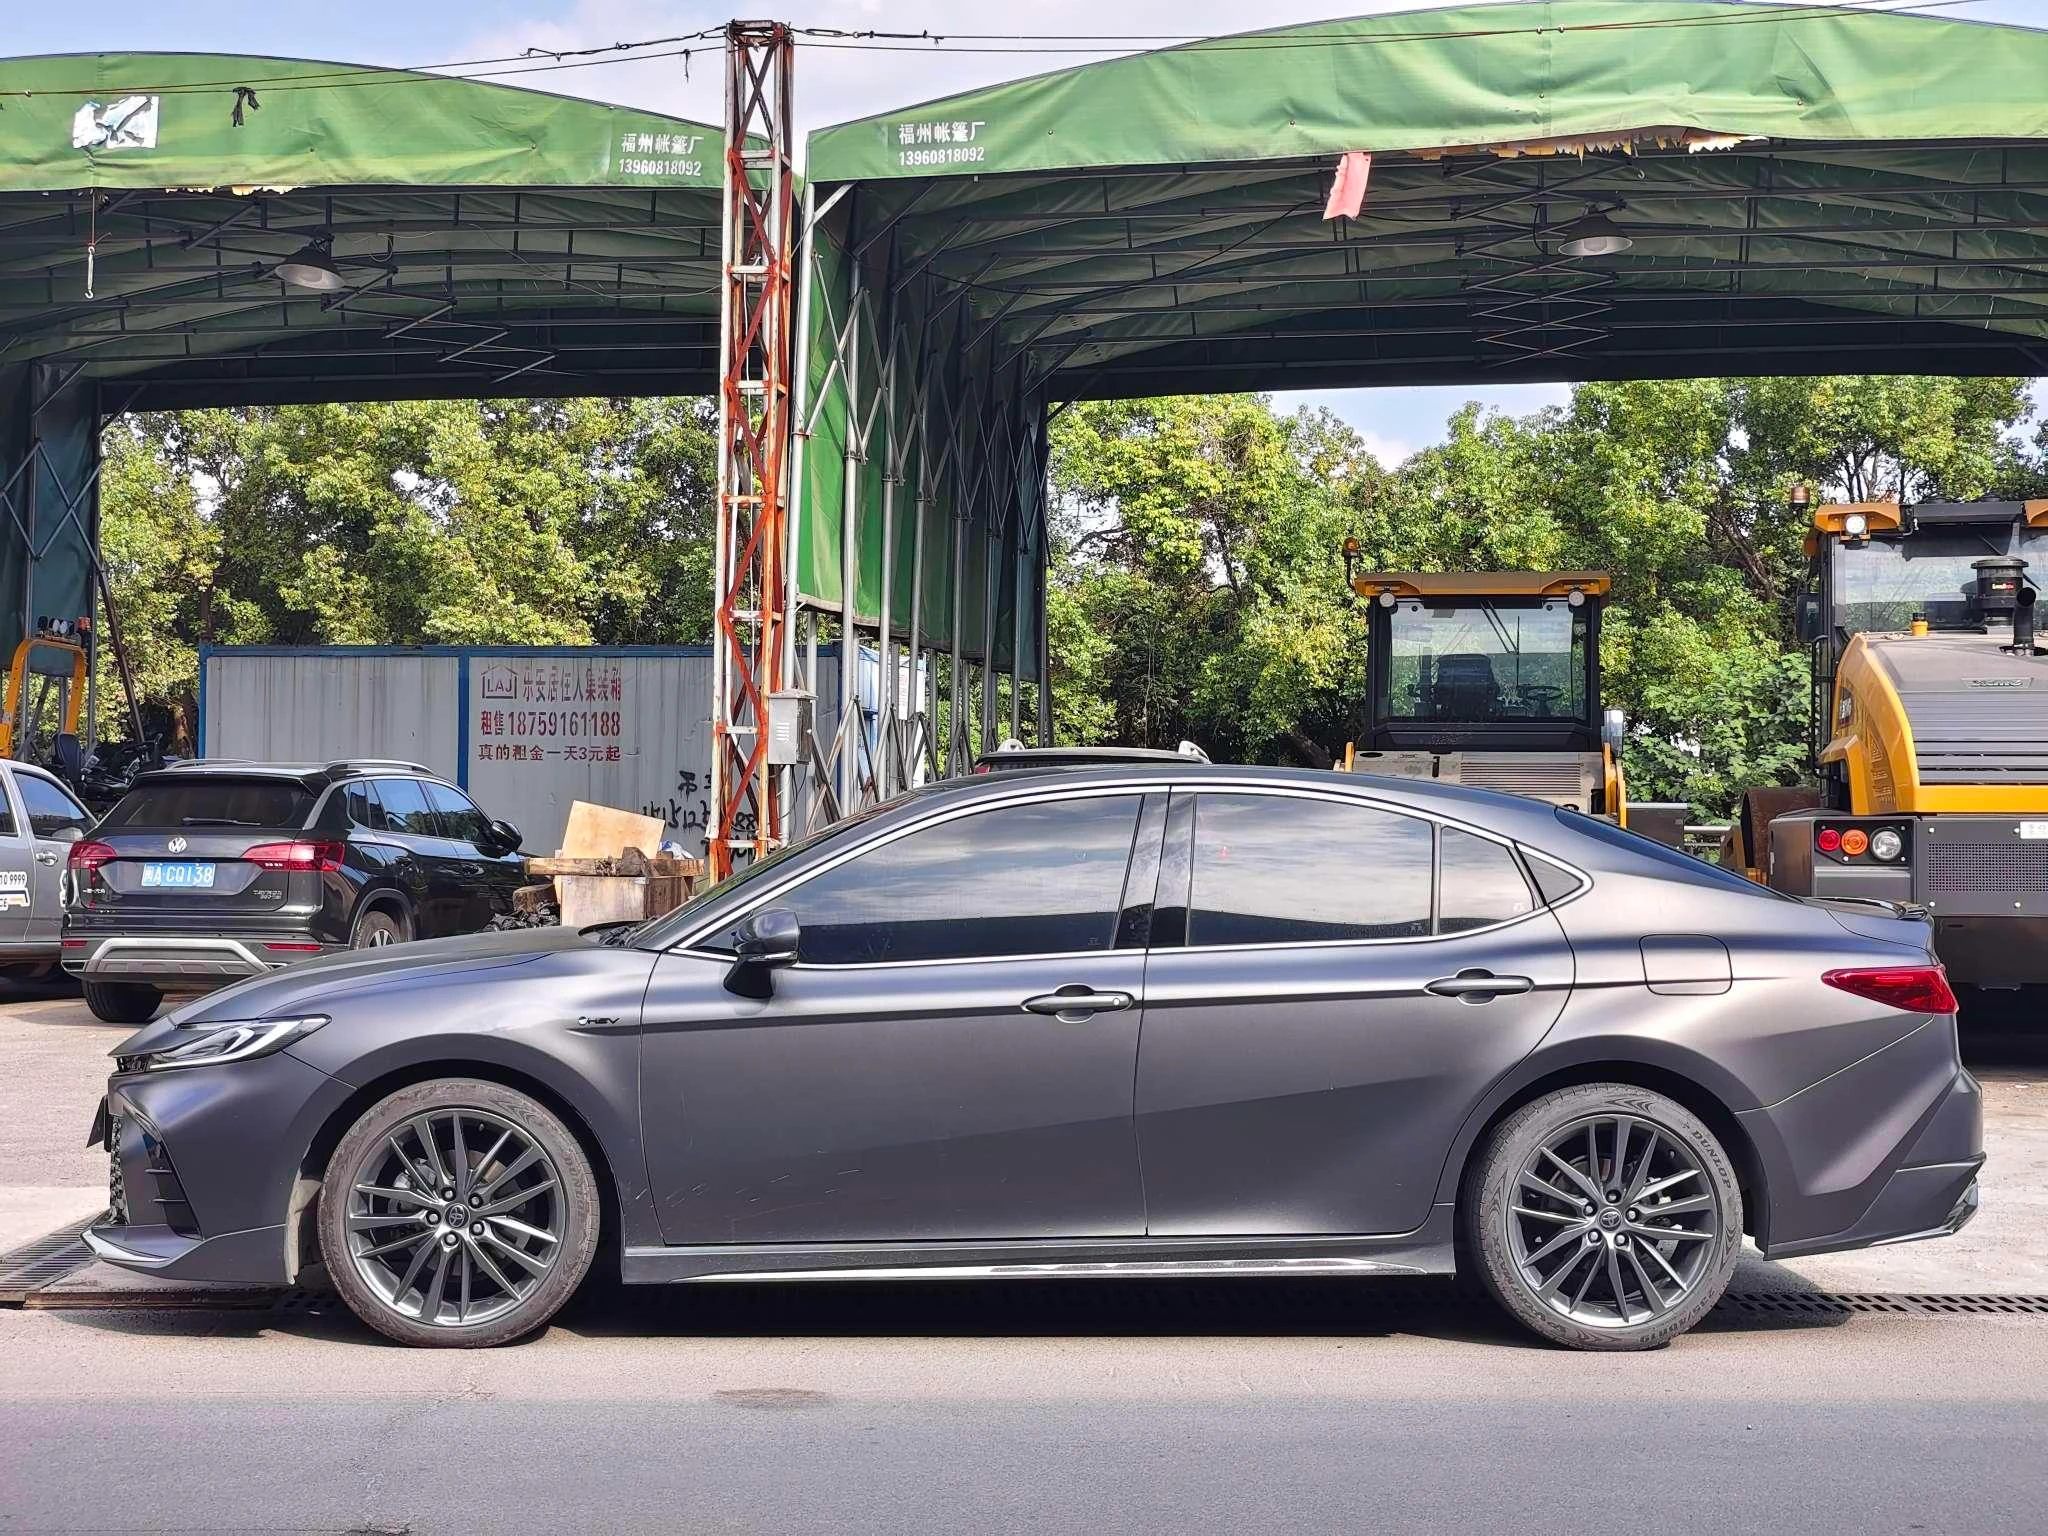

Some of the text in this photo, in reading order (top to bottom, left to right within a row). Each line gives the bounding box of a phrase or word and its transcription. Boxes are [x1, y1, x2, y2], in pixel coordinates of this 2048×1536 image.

[899, 147, 985, 166] 13960818092
[619, 159, 702, 176] 13960818092
[478, 744, 620, 761] 真的租金一天3元起
[1692, 1129, 1731, 1189] DUNLOP
